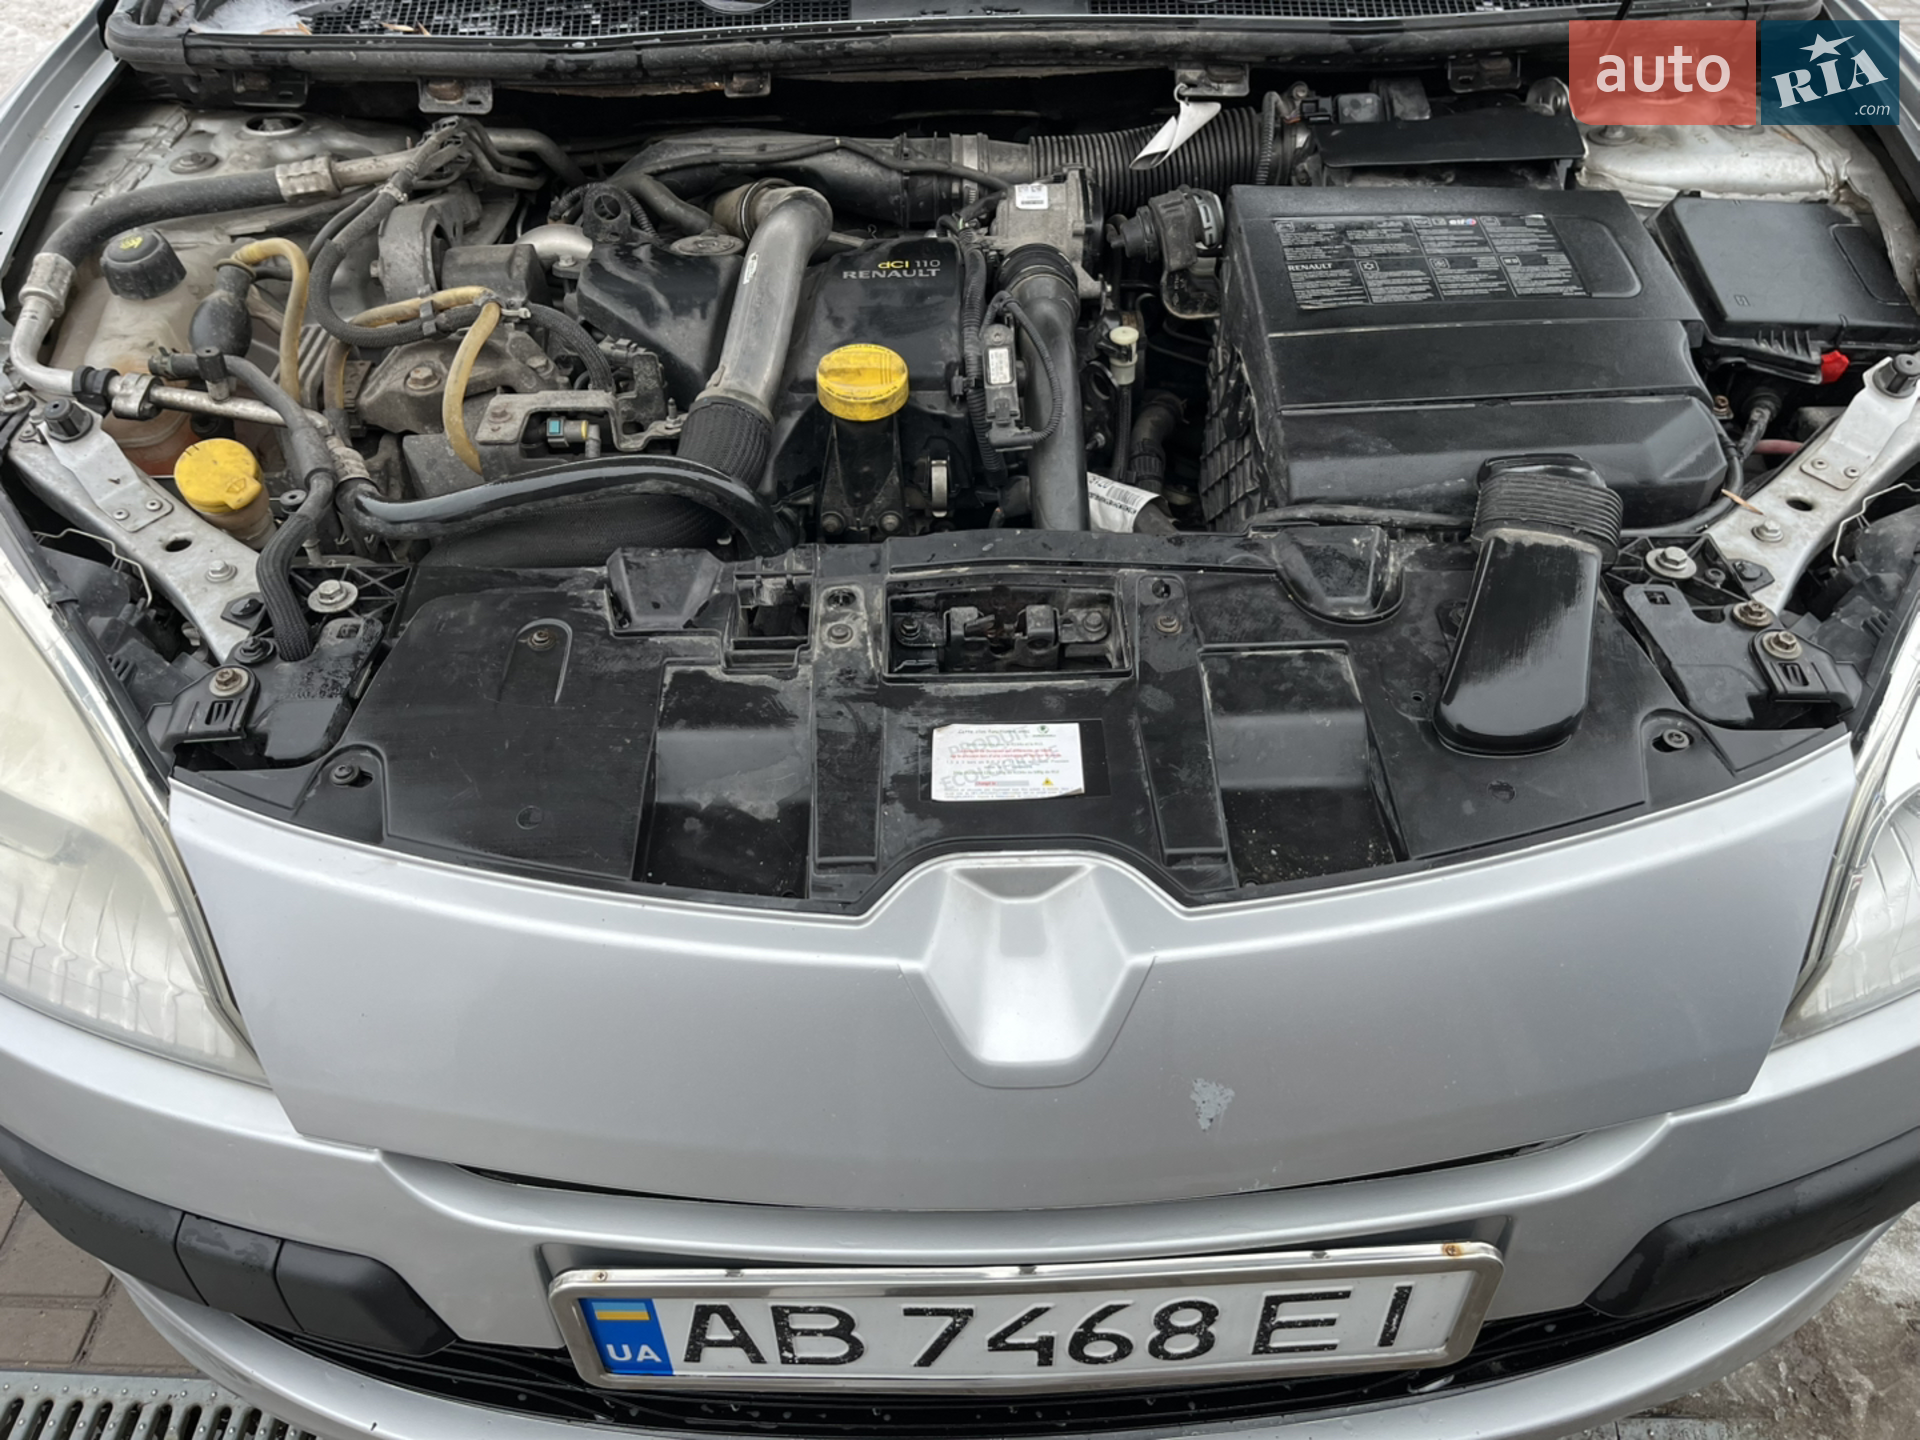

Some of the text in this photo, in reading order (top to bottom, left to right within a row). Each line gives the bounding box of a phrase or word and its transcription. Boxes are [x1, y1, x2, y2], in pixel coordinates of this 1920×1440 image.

[915, 260, 941, 268] 110
[1287, 262, 1333, 272] RENAULT
[843, 268, 941, 279] RENAULT
[947, 725, 1029, 757] PRODUIT
[683, 1284, 1414, 1368] AB 7468 EI
[605, 1343, 662, 1363] UA
